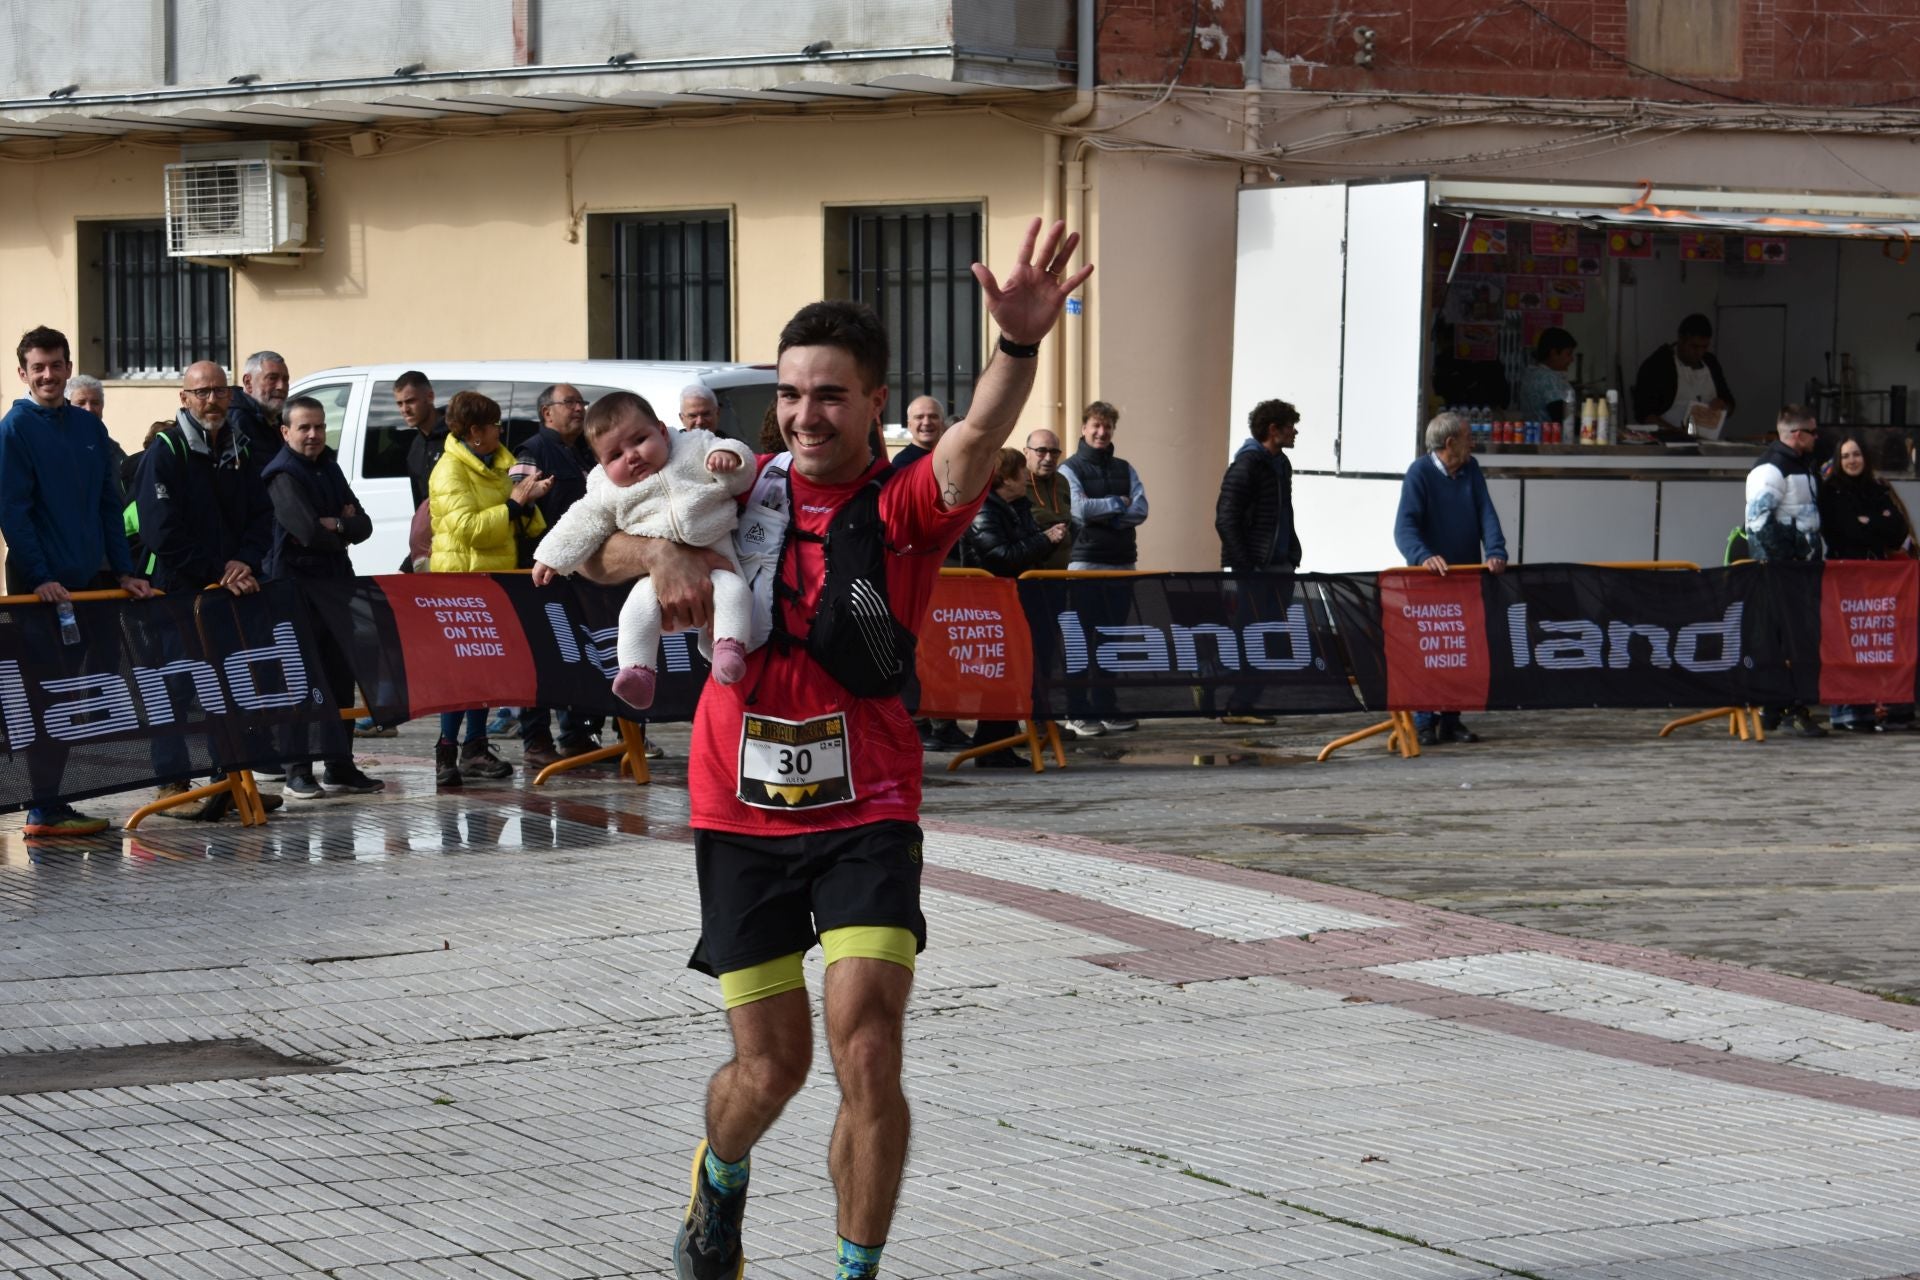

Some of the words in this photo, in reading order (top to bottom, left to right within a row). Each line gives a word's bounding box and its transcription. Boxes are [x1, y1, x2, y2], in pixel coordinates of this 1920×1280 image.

[415, 597, 487, 608] CHANGES
[1841, 597, 1896, 612] CHANGES
[434, 611, 493, 622] STARTS
[932, 608, 1002, 622] CHANGES
[1402, 604, 1462, 618] CHANGES
[1417, 620, 1465, 632] STARTS
[1850, 615, 1895, 629] STARTS
[444, 627, 467, 639] ON
[468, 627, 499, 638] THE
[947, 624, 1004, 640] STARTS
[1057, 604, 1311, 674] land
[1507, 601, 1744, 672] land
[1420, 636, 1440, 650] ON
[1442, 635, 1466, 649] THE
[1851, 634, 1868, 647] ON
[1871, 632, 1894, 646] THE
[454, 643, 505, 657] INSIDE
[948, 645, 973, 660] ON
[976, 643, 1005, 658] THE
[1855, 650, 1894, 664] INSIDE
[1424, 653, 1467, 668] INSIDE
[777, 749, 812, 775] 30
